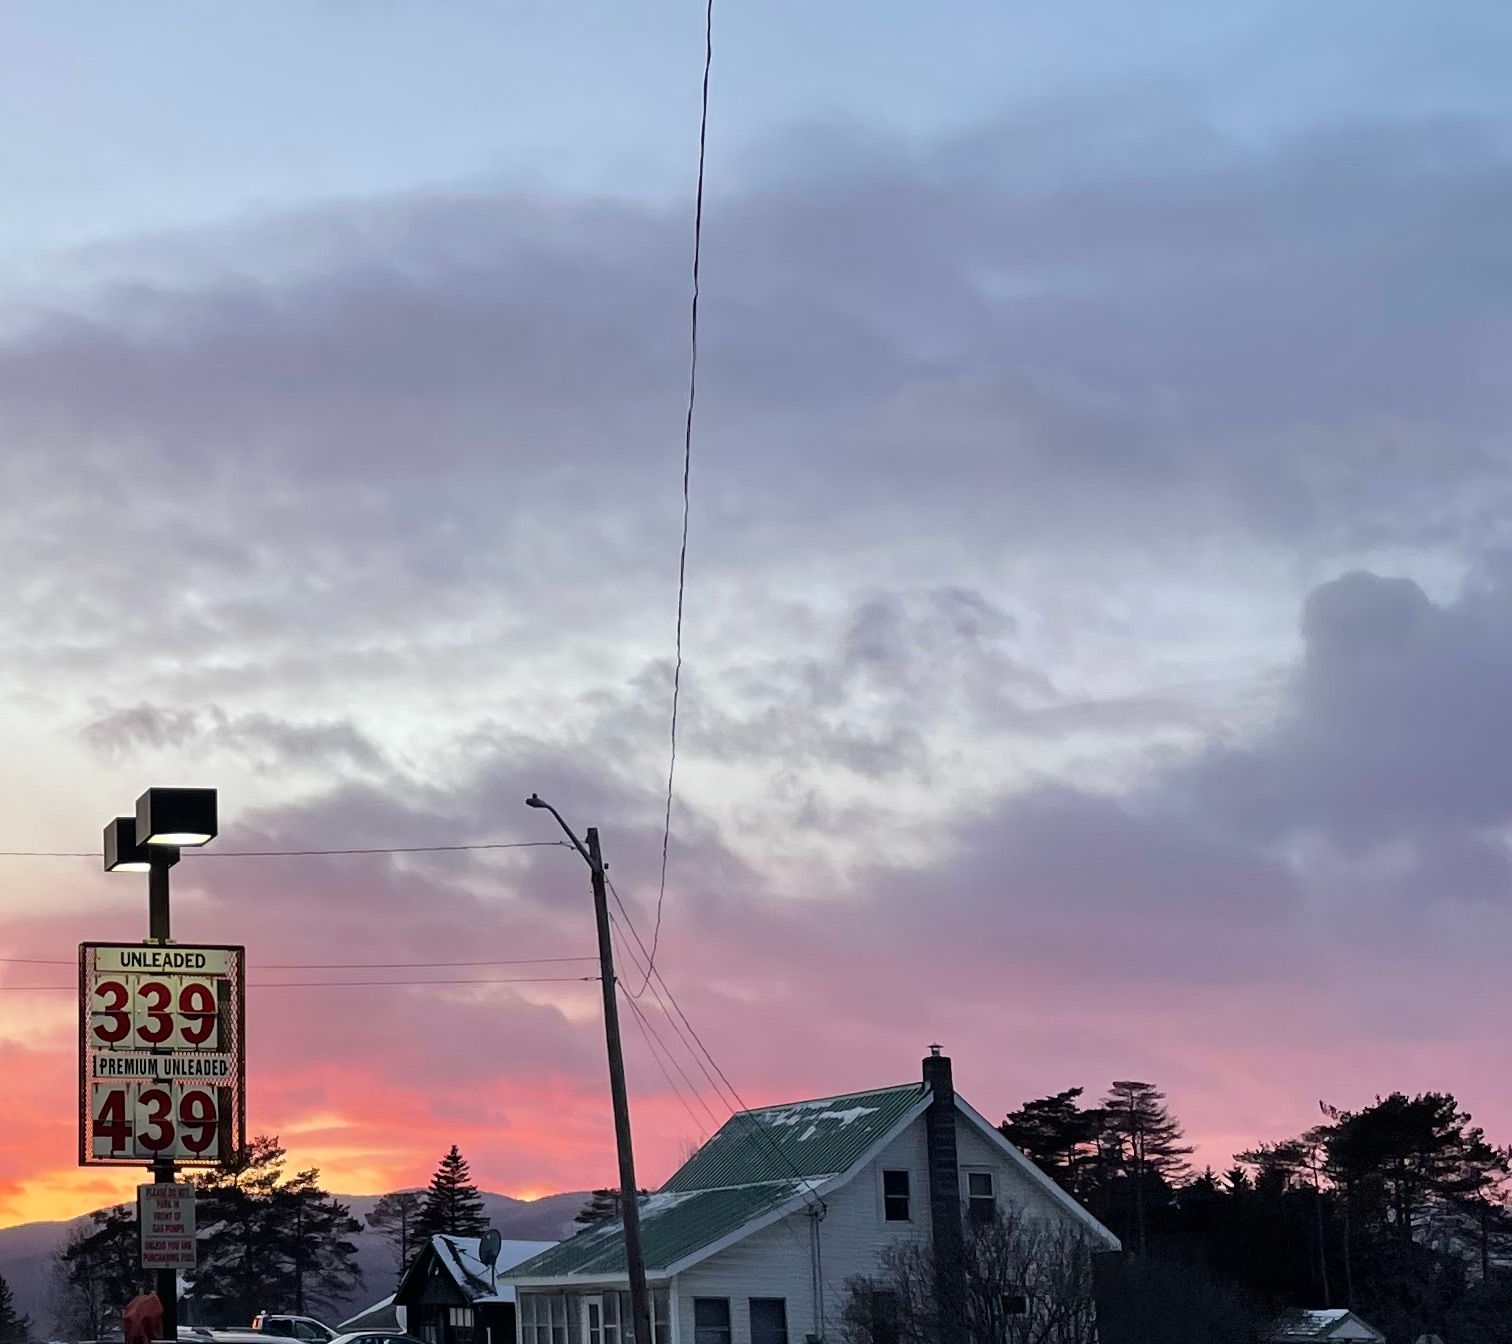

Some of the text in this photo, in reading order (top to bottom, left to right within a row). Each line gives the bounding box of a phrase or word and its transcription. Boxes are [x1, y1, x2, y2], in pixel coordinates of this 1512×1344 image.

[120, 951, 206, 969] UNLEADED
[92, 980, 216, 1045] 339
[99, 1058, 227, 1076] PREMIUM UNLEADED
[92, 1088, 217, 1153] 439
[153, 1211, 182, 1221] FRONT OF
[152, 1223, 185, 1234] GAS PUMPS
[144, 1240, 167, 1250] UNLESS
[143, 1253, 180, 1263] PURCHASING
